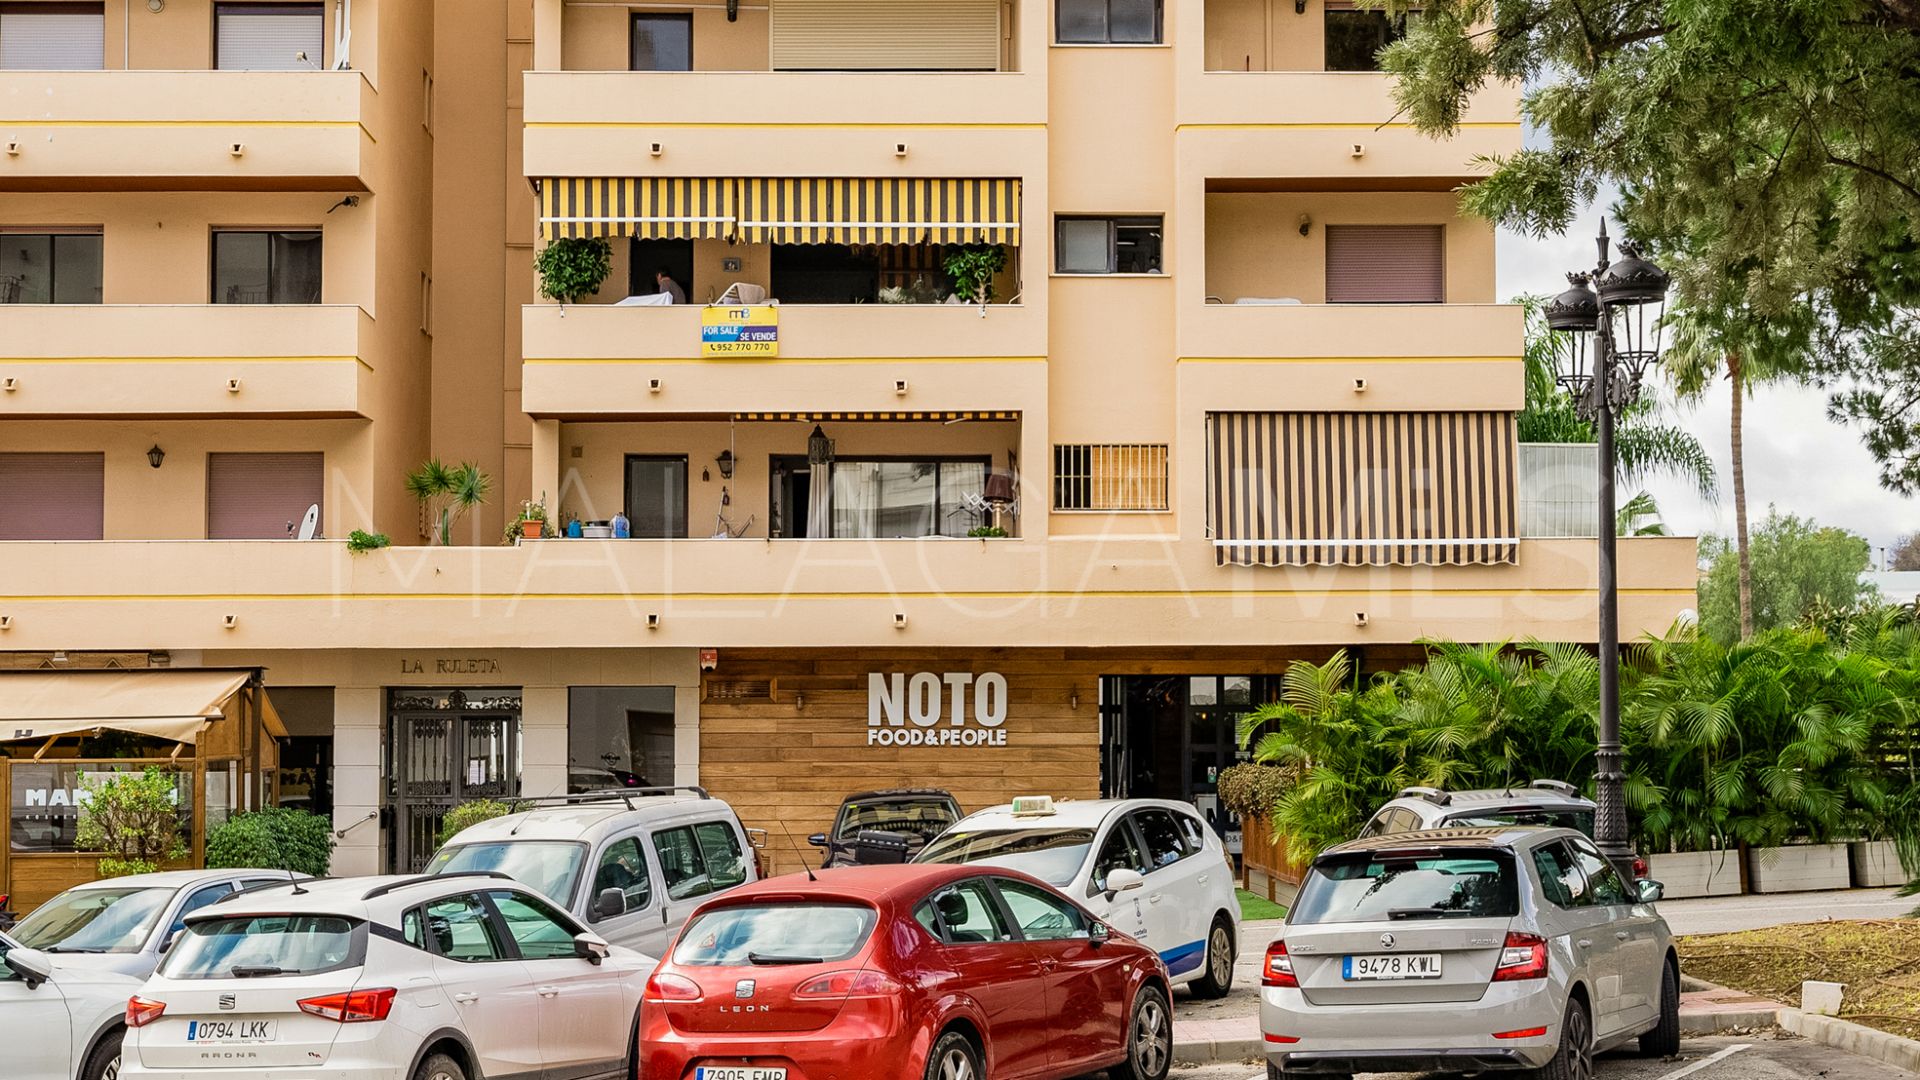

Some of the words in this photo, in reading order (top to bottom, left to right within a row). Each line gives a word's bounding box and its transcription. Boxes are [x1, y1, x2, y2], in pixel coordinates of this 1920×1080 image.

[703, 326, 719, 335] FOR
[720, 326, 739, 335] SALE
[740, 332, 750, 341] SE
[751, 332, 777, 341] VENDE
[717, 343, 733, 351] 952
[735, 343, 752, 351] 770
[754, 343, 770, 351] 770
[401, 659, 424, 674] LA
[436, 659, 502, 674] RULETA
[868, 671, 1008, 727] NOTO
[867, 728, 1007, 746] FOOD&PEOPLE
[1358, 956, 1401, 974] 9478
[1407, 956, 1440, 973] KWL
[720, 1005, 769, 1013] LEON
[199, 1022, 234, 1039] 0794
[240, 1021, 269, 1038] LKK
